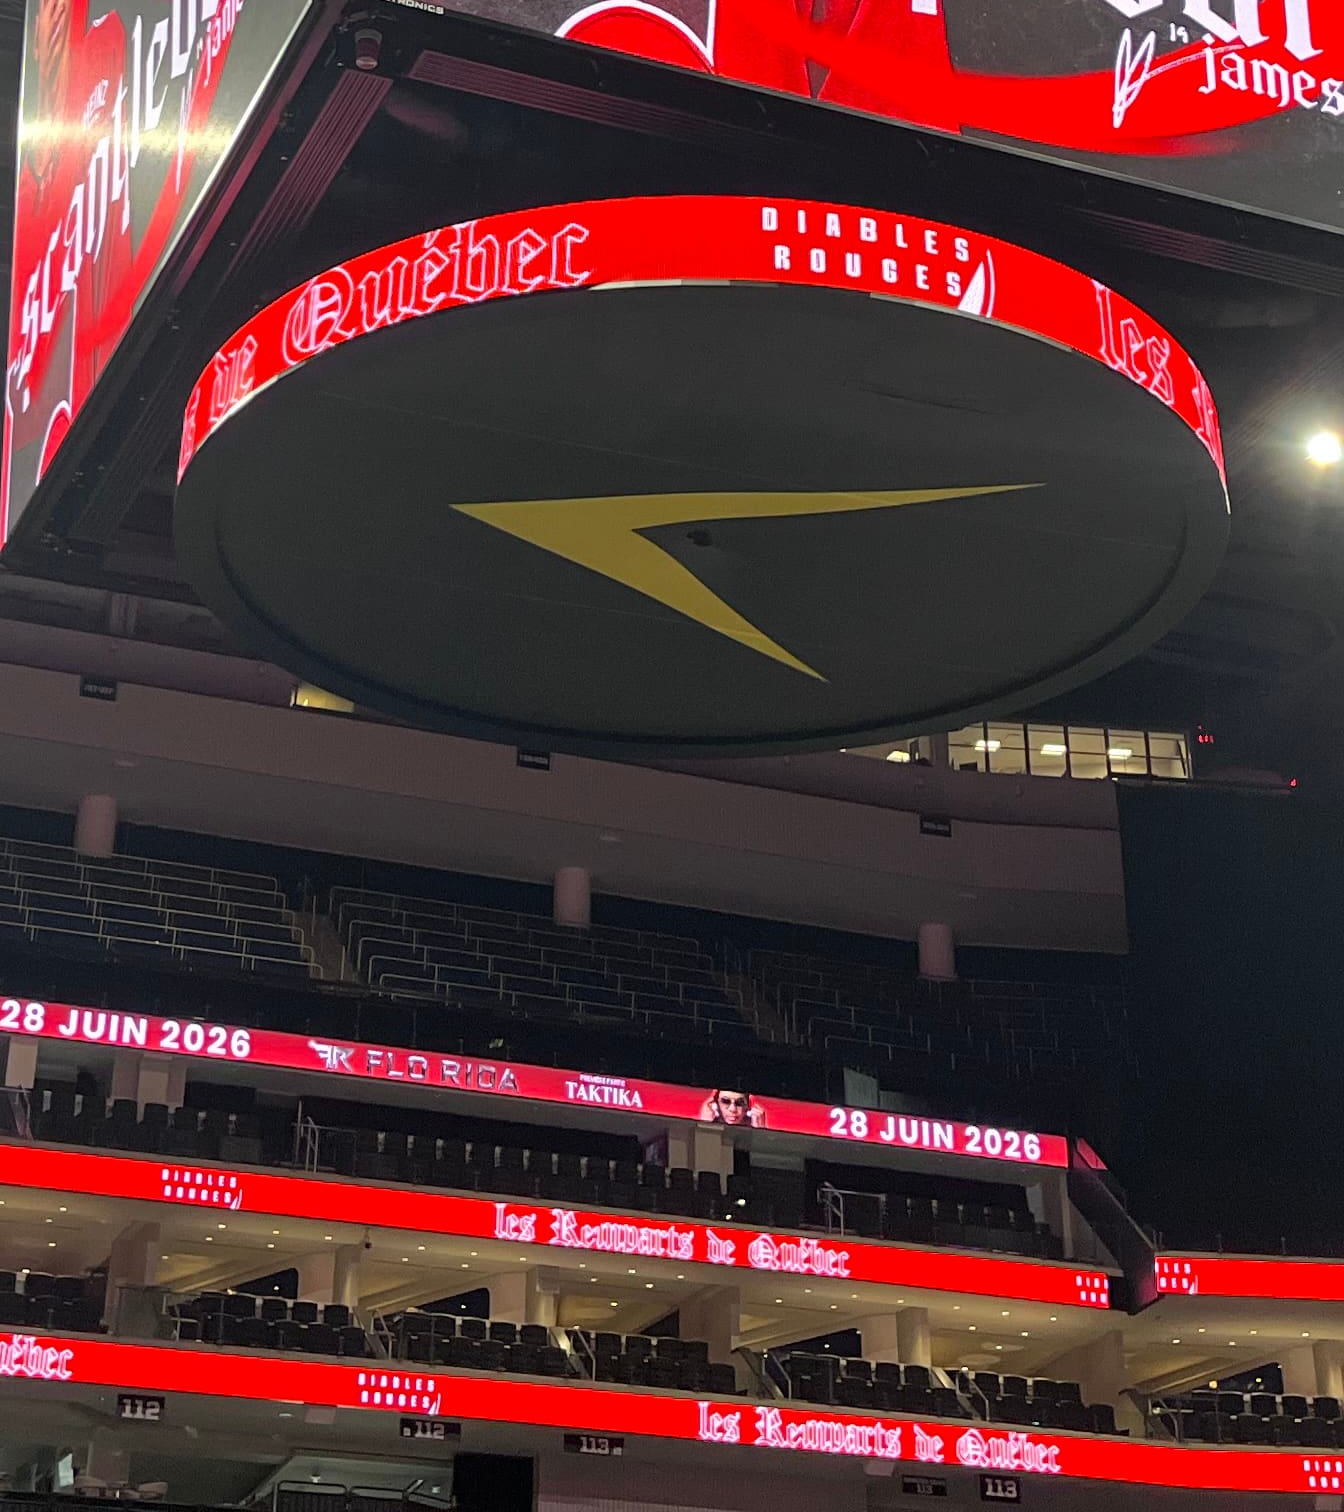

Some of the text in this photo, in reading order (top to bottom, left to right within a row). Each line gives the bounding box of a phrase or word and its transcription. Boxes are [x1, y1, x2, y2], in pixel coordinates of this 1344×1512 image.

[761, 206, 970, 263] DIABLES
[282, 220, 592, 366] Québec
[774, 244, 962, 297] ROUGES
[1091, 278, 1175, 405] les
[58, 1008, 148, 1048] JUIN
[159, 1019, 252, 1060] 2026
[366, 1048, 429, 1080] FLO
[565, 1080, 643, 1108] TAKTIKA
[828, 1104, 1042, 1161] 28 JUIN 2026
[493, 1202, 537, 1242] les
[548, 1207, 696, 1261] Remparts
[705, 1229, 737, 1265] de
[120, 1396, 161, 1422] 112
[414, 1421, 445, 1440] 112
[697, 1401, 740, 1444] les
[754, 1406, 902, 1460] Remparts
[912, 1424, 944, 1462] de
[580, 1436, 610, 1454] 113
[985, 1477, 1018, 1499] 113
